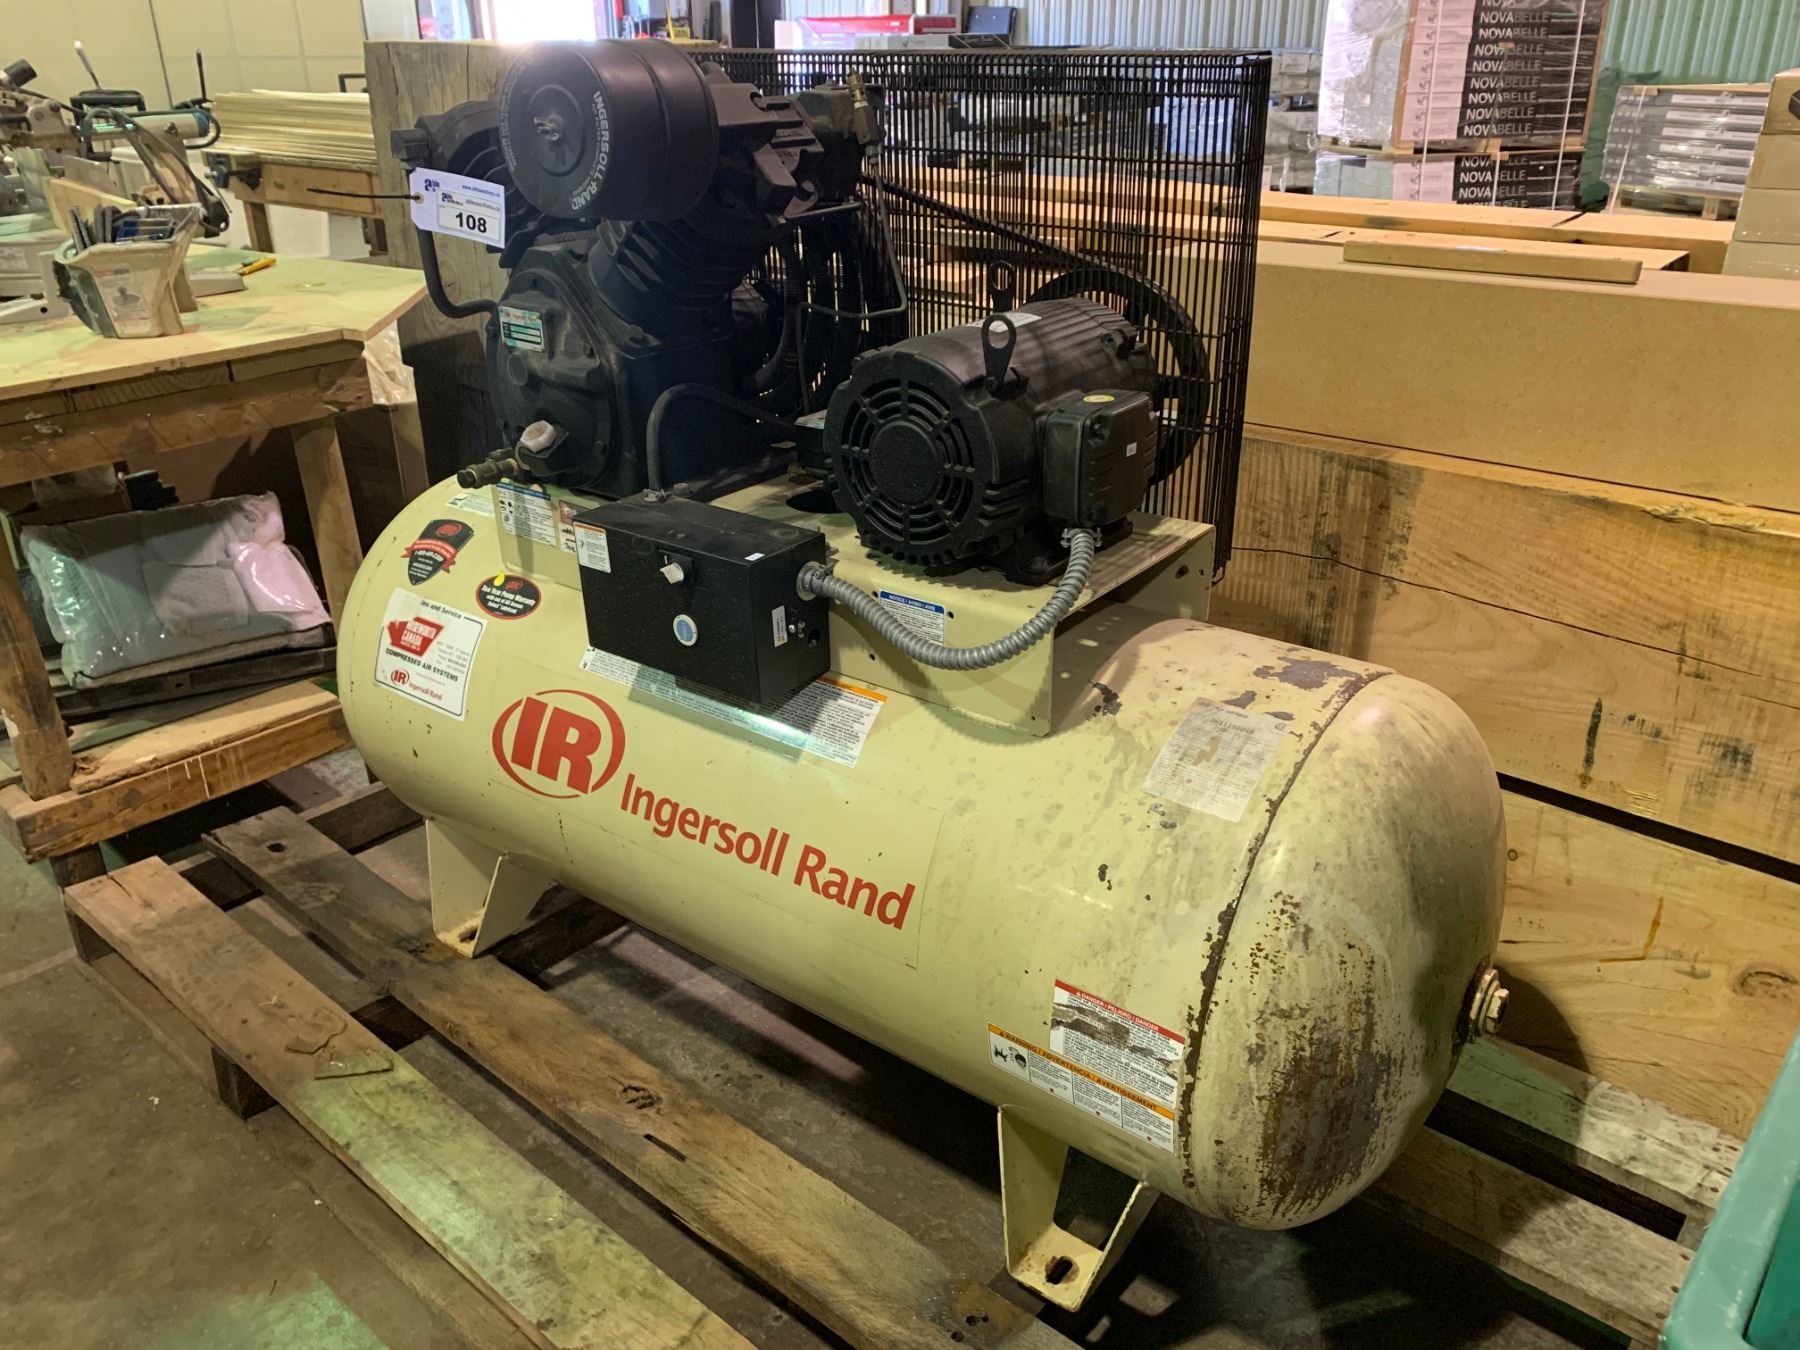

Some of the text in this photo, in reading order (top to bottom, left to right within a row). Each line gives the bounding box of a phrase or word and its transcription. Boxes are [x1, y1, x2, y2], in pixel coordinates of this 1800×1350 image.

[1459, 170, 1527, 183] NOVAELLE
[1458, 185, 1526, 199] NOVAELLE
[455, 212, 488, 233] 108
[430, 602, 441, 611] and
[441, 606, 462, 619] Service
[385, 647, 421, 666] COMPRESSED
[422, 661, 432, 671] AIR
[432, 665, 459, 682] SYSTEMS
[393, 669, 407, 685] IR
[408, 681, 443, 701] Ingersoll Rand
[511, 696, 602, 794] IR
[620, 773, 916, 930] Ingersoll Rand
[1081, 992, 1105, 1006] DANGER
[1107, 1004, 1131, 1019] PELIGRO
[1135, 1017, 1159, 1032] DANGER
